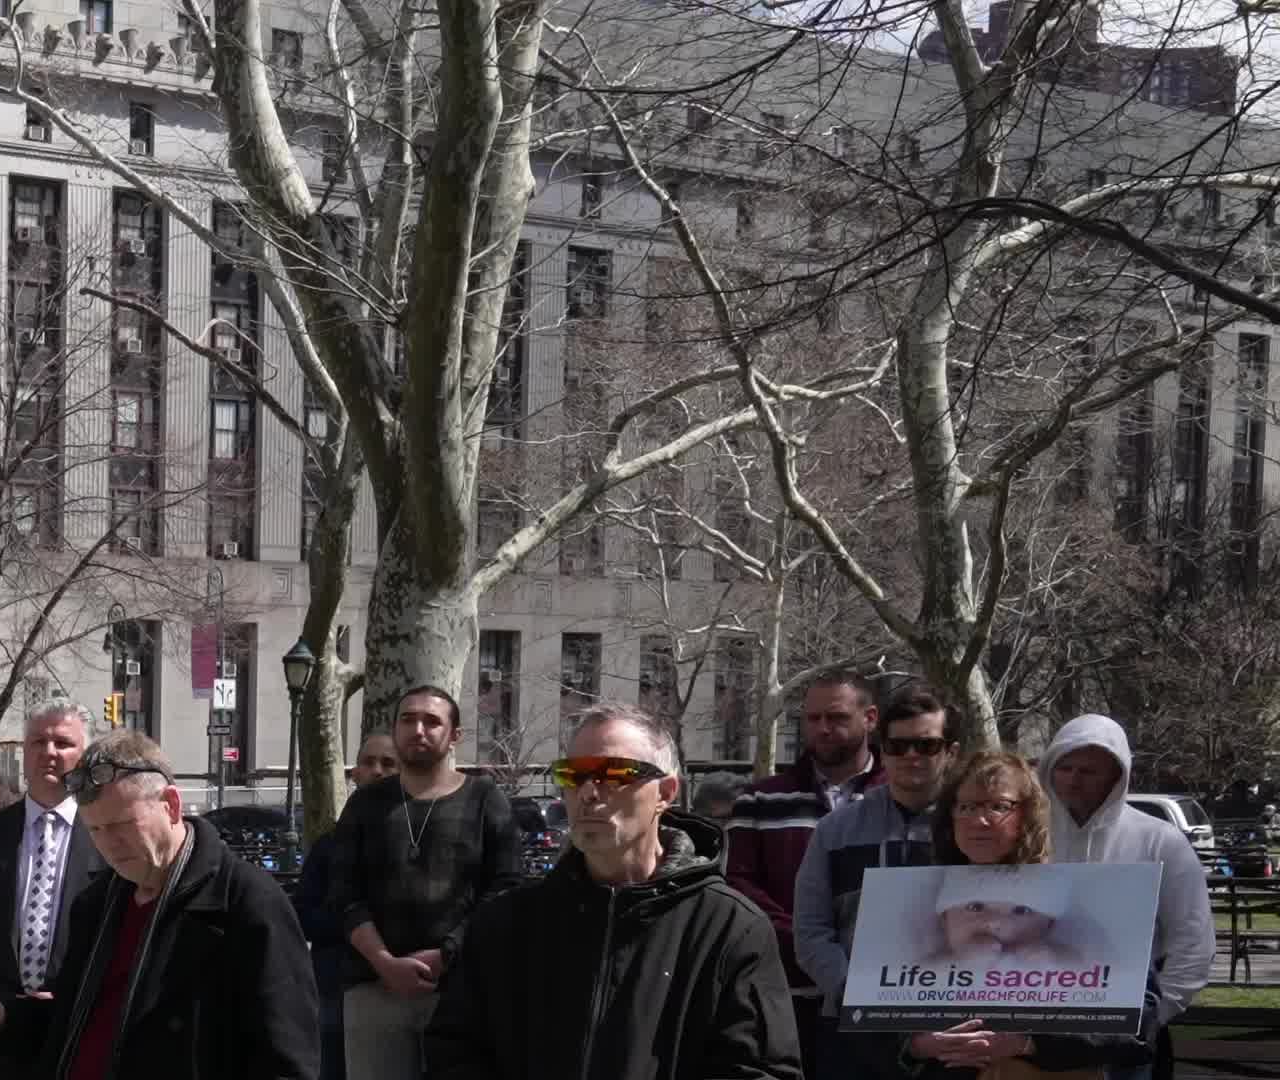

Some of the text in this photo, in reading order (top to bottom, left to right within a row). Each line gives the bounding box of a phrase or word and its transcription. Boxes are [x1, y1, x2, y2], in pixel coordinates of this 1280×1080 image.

[879, 965, 1111, 988] Life is sacred!
